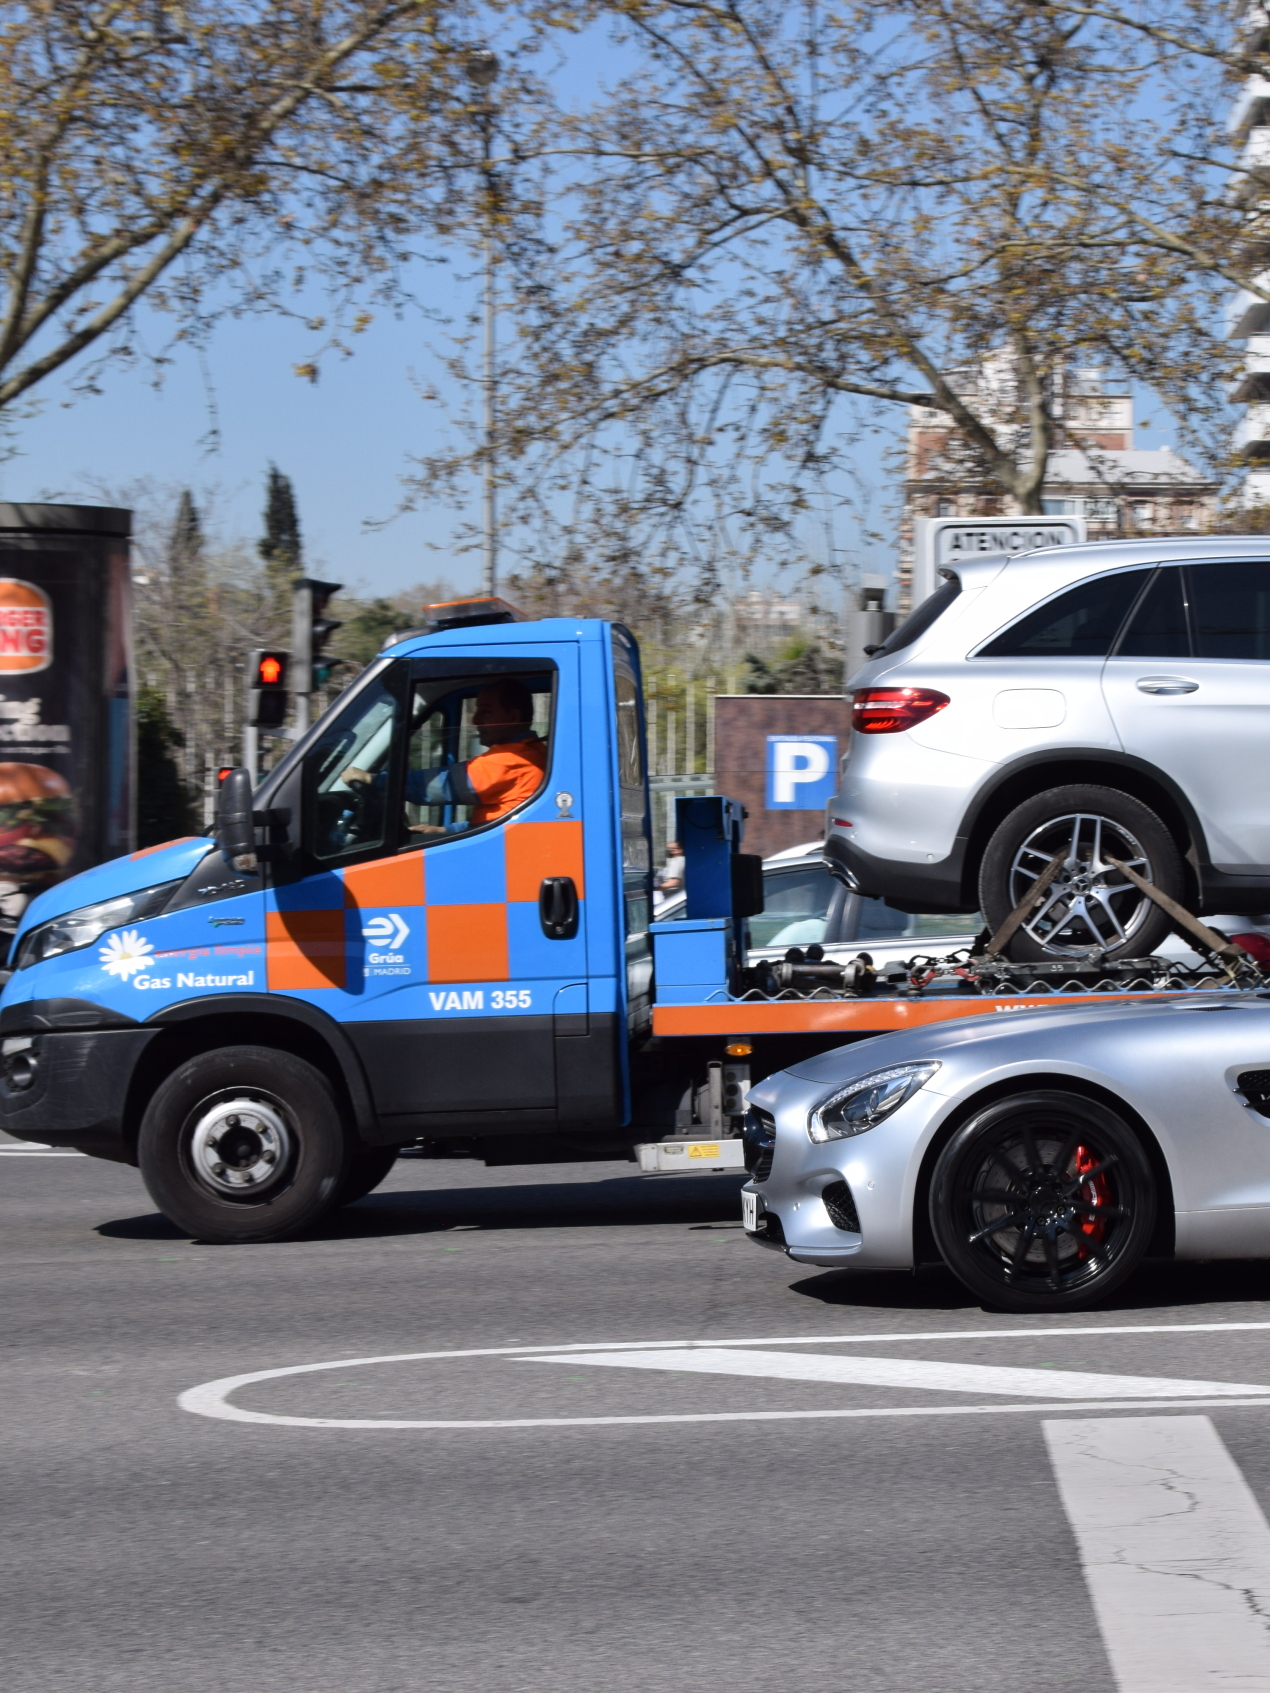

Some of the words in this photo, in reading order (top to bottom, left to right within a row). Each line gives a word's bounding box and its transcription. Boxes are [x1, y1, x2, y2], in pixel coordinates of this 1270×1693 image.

[773, 742, 830, 803] P
[368, 952, 404, 964] Grúa
[133, 975, 171, 990] Gas
[177, 970, 254, 988] Natural
[374, 967, 412, 976] MADRID
[429, 991, 484, 1011] VAM
[490, 990, 532, 1009] 355
